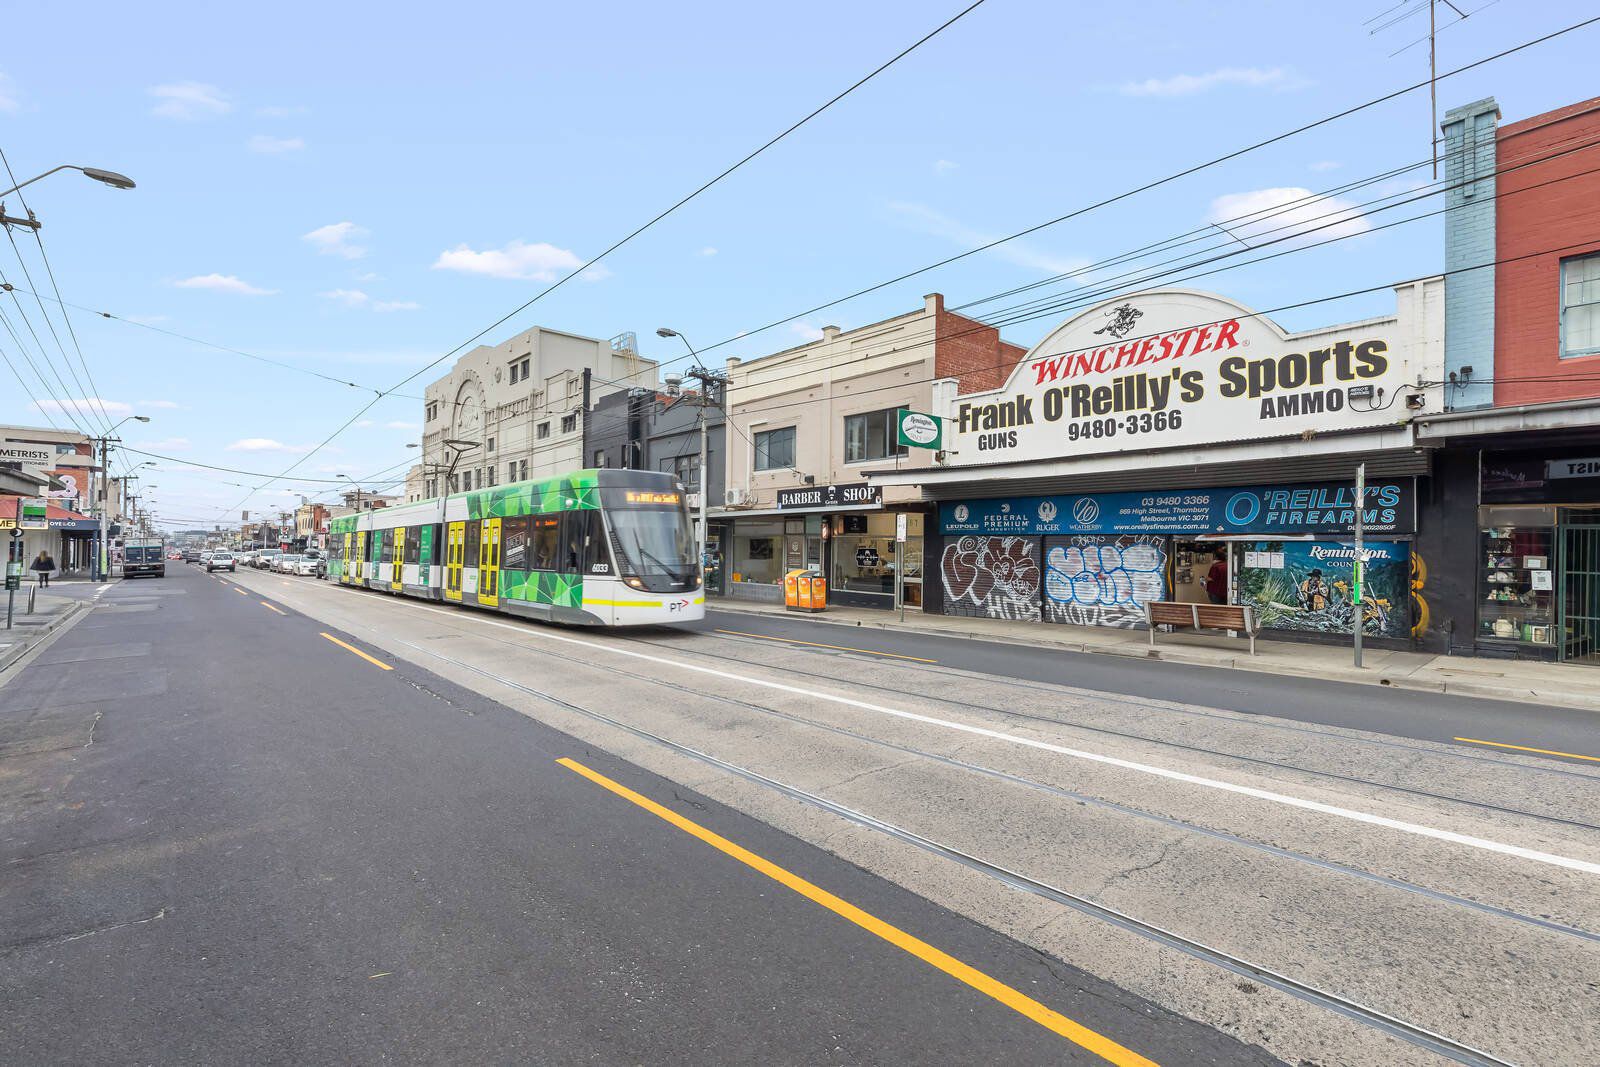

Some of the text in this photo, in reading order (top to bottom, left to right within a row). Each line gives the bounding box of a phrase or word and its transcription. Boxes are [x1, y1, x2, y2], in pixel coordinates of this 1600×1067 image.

[1031, 318, 1241, 386] WINCHESTER
[958, 340, 1389, 434] Frank O'Reilly's Sports
[1260, 388, 1344, 420] AMMO
[978, 430, 1018, 451] GUNS
[781, 487, 876, 505] BARBER SHOP
[1141, 495, 1210, 506] 03 9480 3366
[1132, 508, 1147, 516] High
[1173, 507, 1210, 515] Thornbury
[1266, 509, 1396, 525] FIREARMS
[1113, 523, 1210, 532] www.oreillysfirearms.com.au
[592, 563, 609, 573] 6033
[1326, 561, 1371, 569] COUNY
